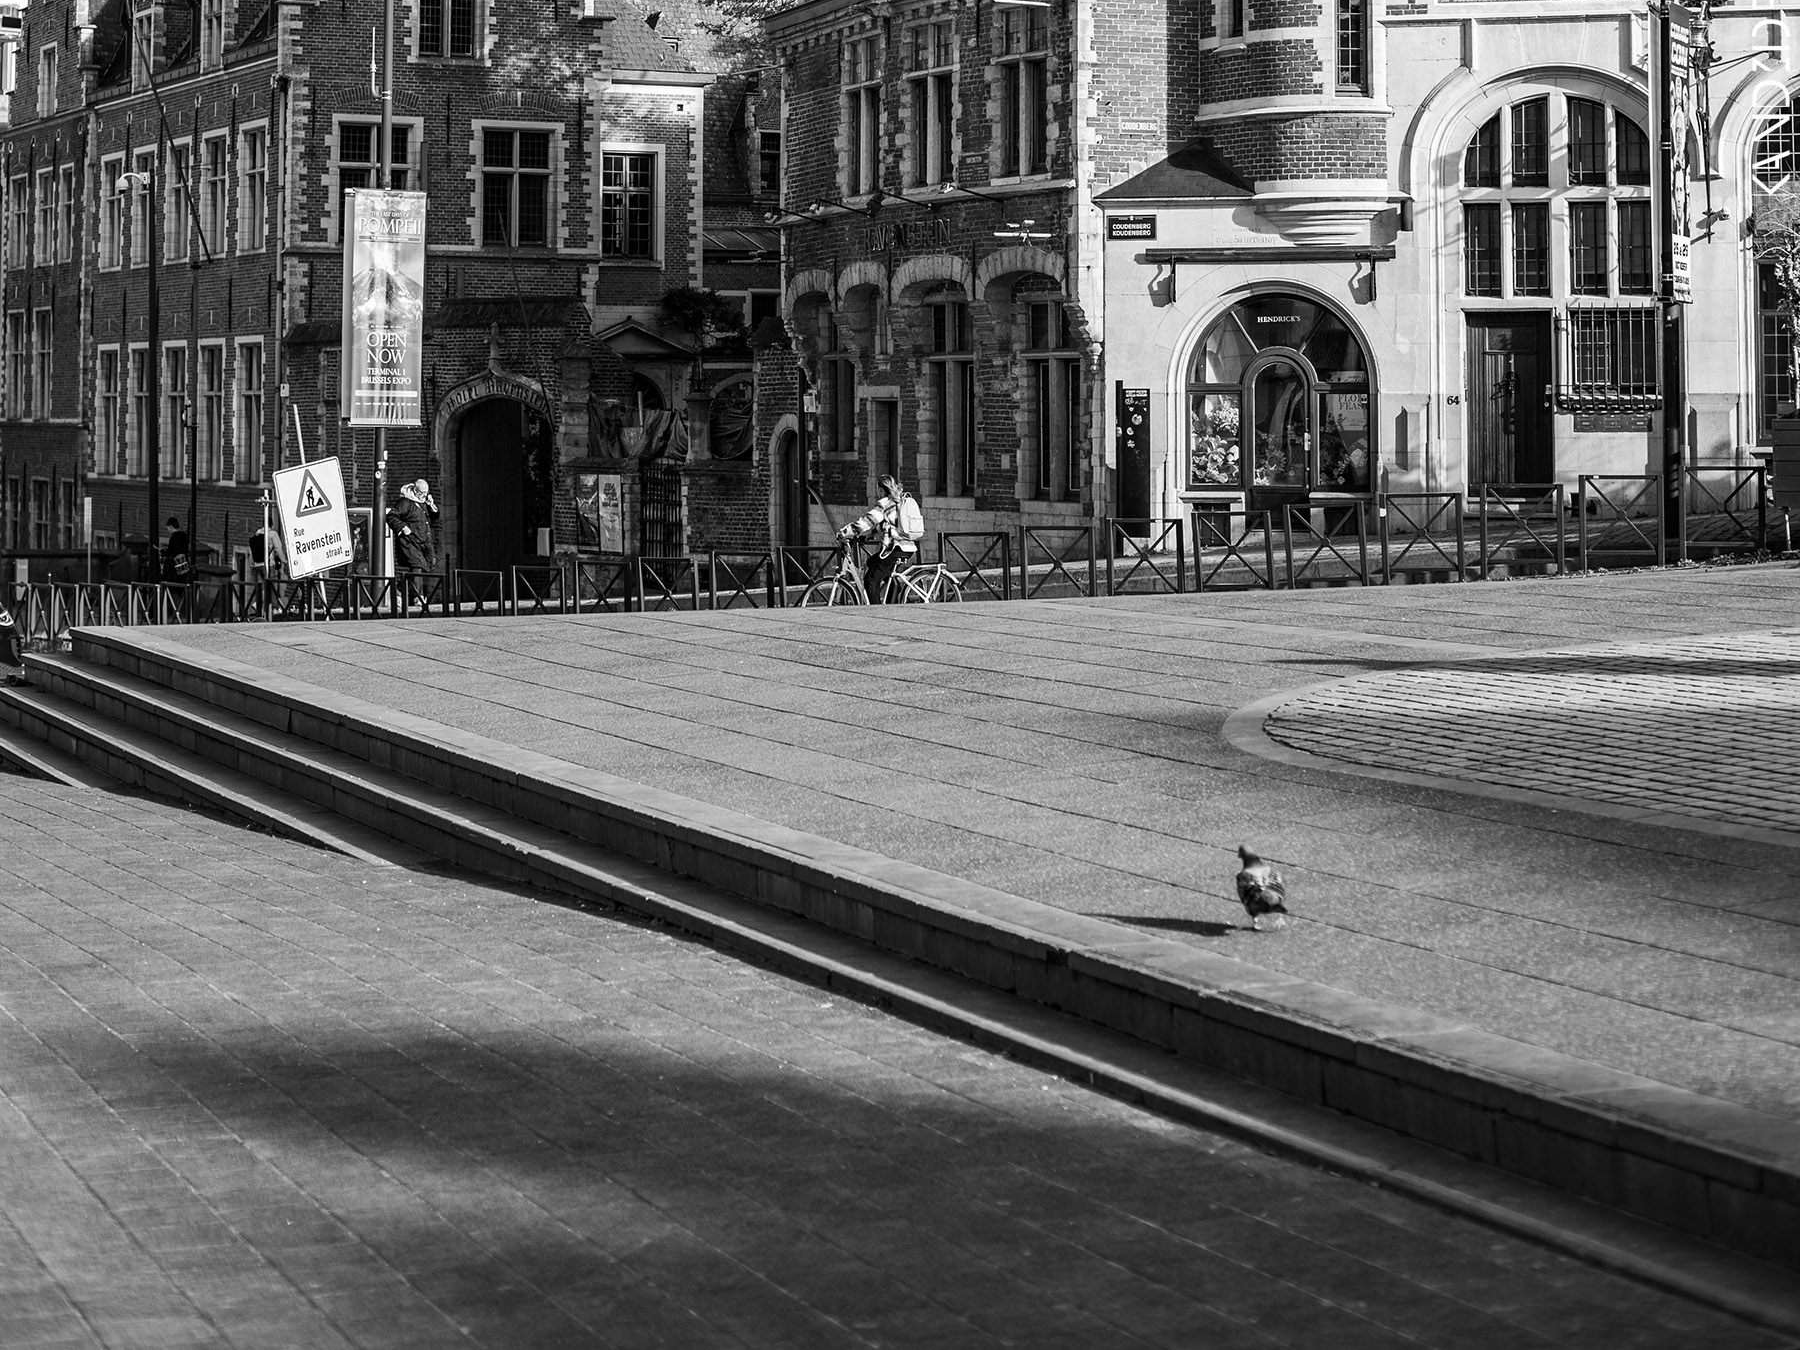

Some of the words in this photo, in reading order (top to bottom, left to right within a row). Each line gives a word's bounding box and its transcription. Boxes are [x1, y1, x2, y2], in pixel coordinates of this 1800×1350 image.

[1121, 122, 1158, 130] COUDENBERG
[358, 217, 421, 235] POMPEII
[864, 218, 951, 251] RAVENSTEIN
[1257, 315, 1301, 323] HENDRICK'S
[366, 332, 407, 347] OPEN
[367, 349, 407, 364] NOW
[368, 367, 401, 376] TERMINAL
[361, 376, 391, 384] BRUSSELS
[392, 377, 412, 385] EXPO
[1446, 395, 1460, 405] 64
[293, 527, 305, 538] Rue
[295, 530, 342, 555] Ravenstein
[325, 546, 343, 559] straat
